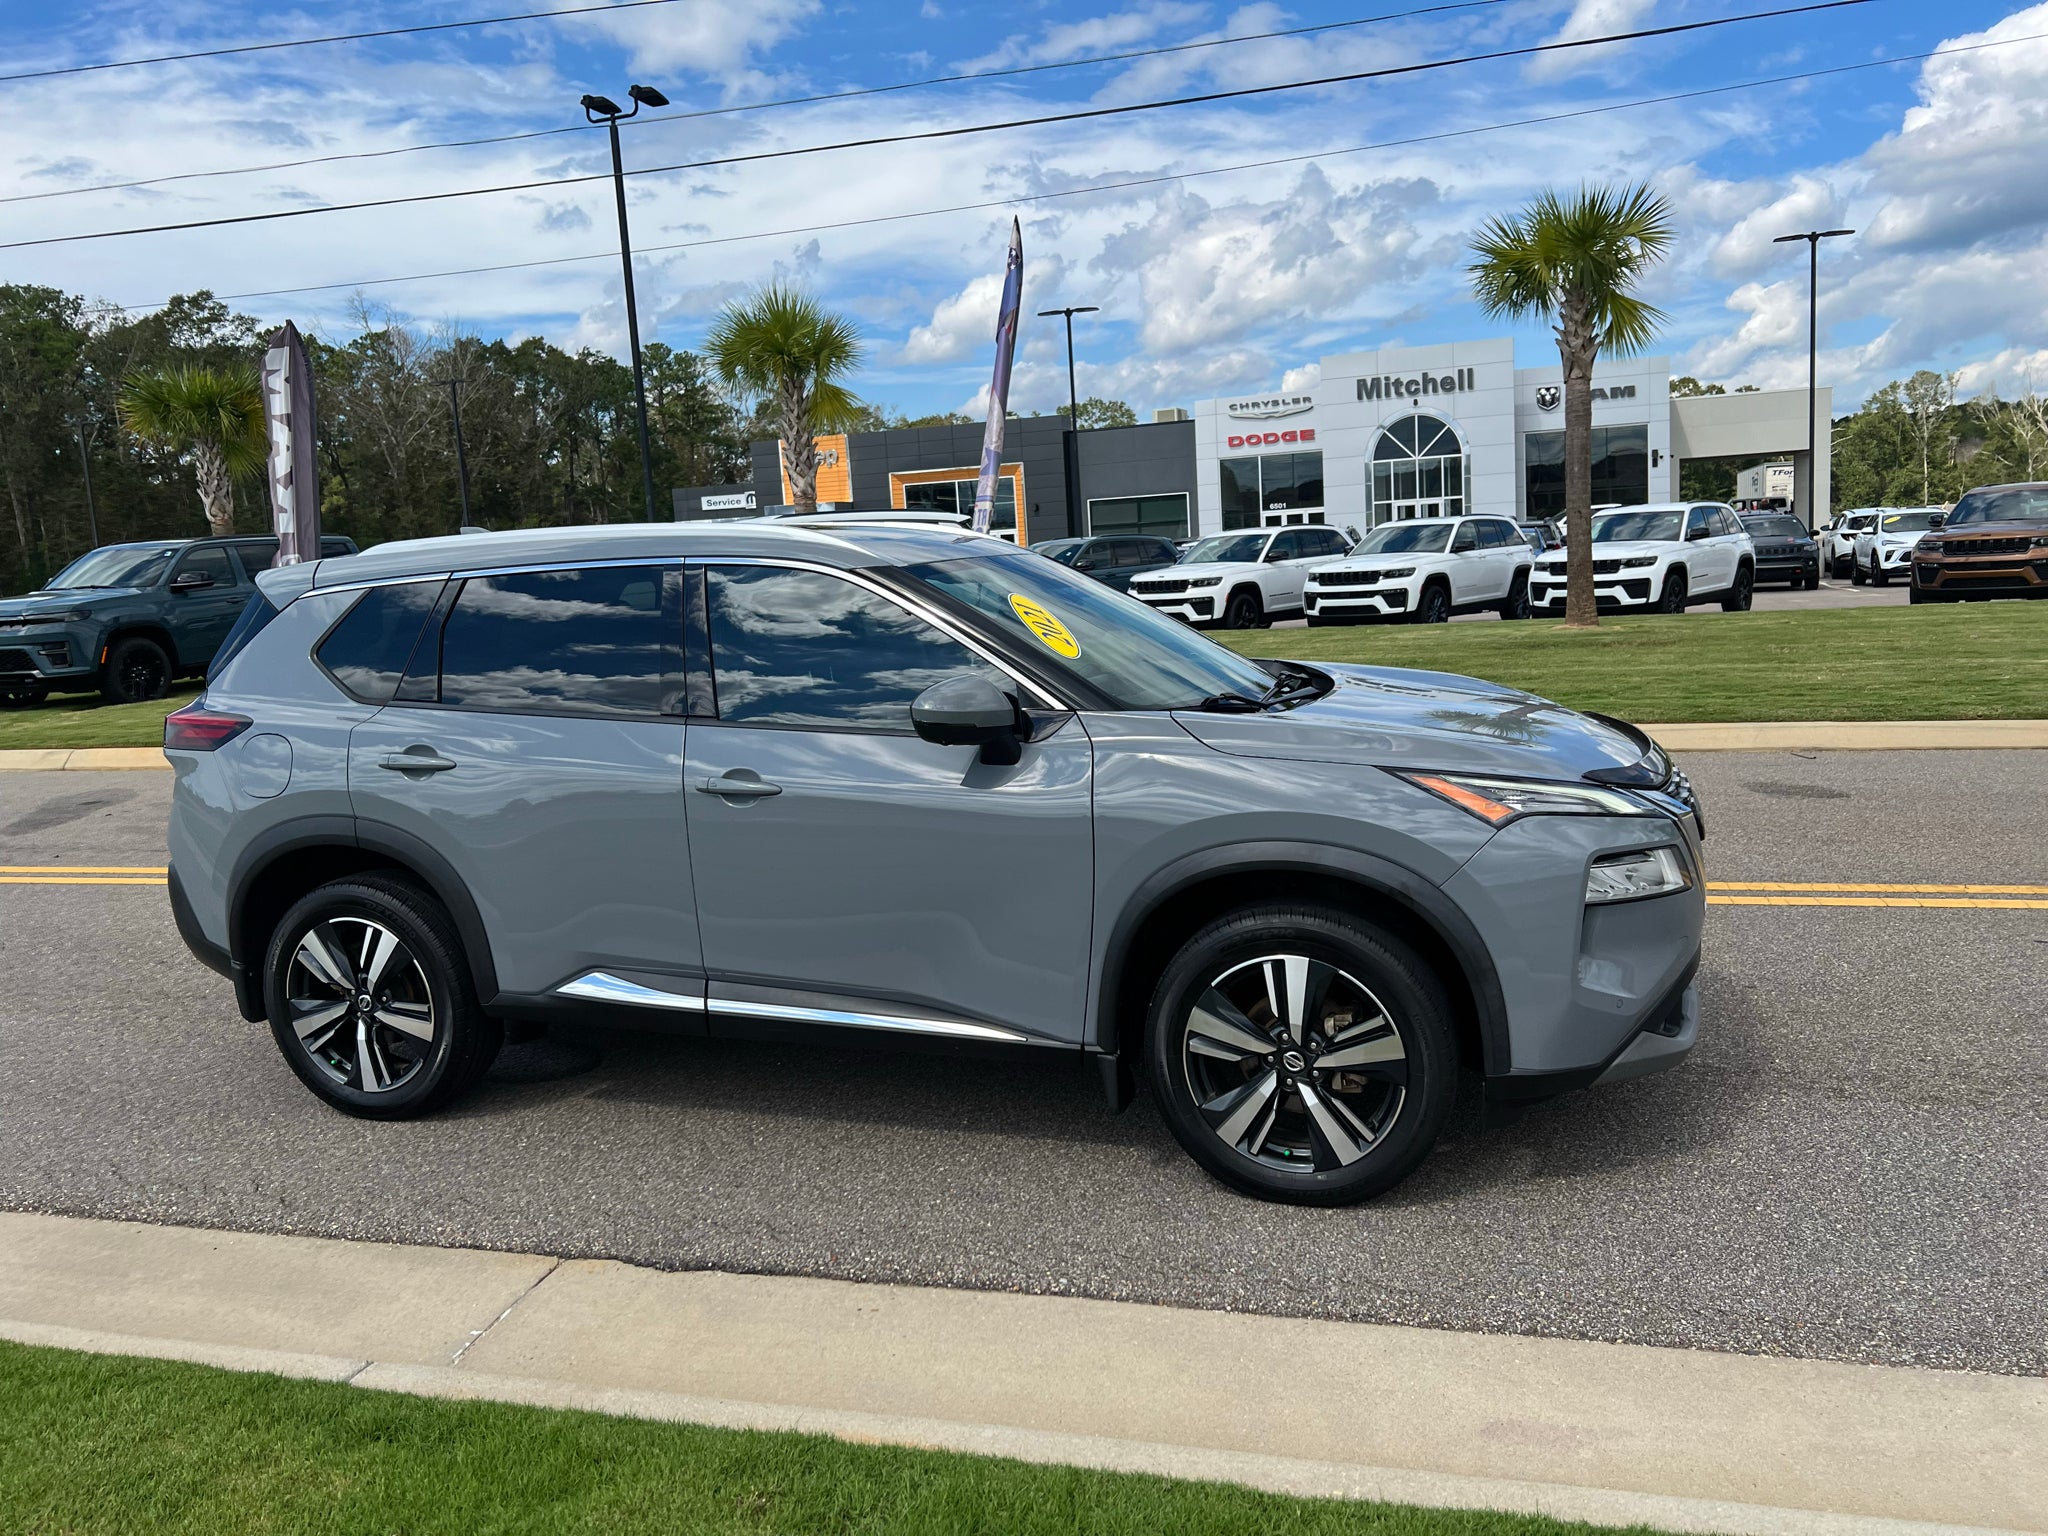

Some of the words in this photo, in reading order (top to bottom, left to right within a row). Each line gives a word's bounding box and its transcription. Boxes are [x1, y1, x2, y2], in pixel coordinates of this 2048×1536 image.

[1357, 367, 1474, 401] Mitchell
[1590, 385, 1636, 401] AM
[1228, 396, 1313, 411] CHRYSLER
[1227, 428, 1316, 448] DODGE
[1772, 469, 1794, 477] TFor
[706, 498, 741, 507] Service
[1269, 502, 1287, 510] 6501
[1014, 601, 1074, 648] 2021
